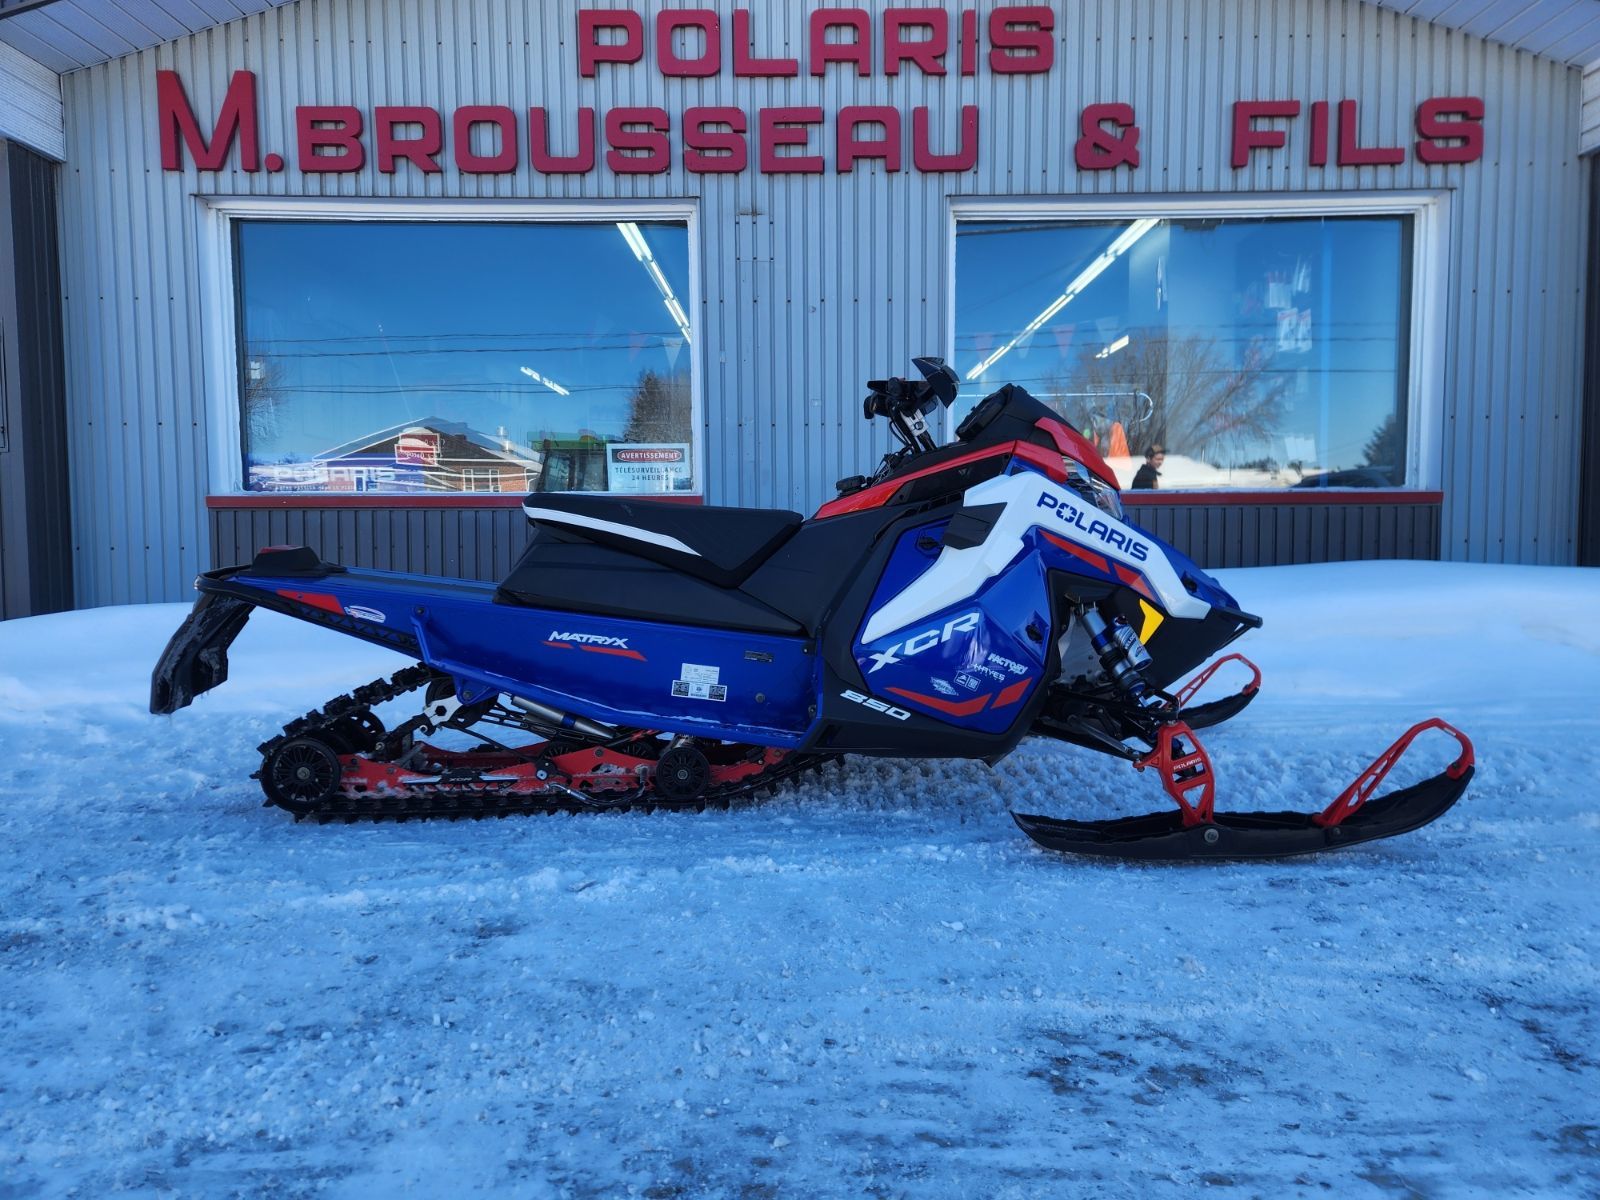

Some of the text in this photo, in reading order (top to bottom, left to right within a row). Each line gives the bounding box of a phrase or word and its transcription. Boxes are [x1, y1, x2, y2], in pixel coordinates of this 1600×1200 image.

[578, 6, 1055, 77] POLARIS
[1075, 102, 1140, 171] &
[1231, 97, 1484, 169] FILS
[621, 452, 678, 460] AVERTISSEMENT
[1036, 491, 1150, 562] POLARIS
[548, 630, 629, 649] MATRYX
[867, 612, 980, 674] XCR
[988, 653, 1028, 674] FACTORY
[1173, 757, 1202, 771] POLARIS
